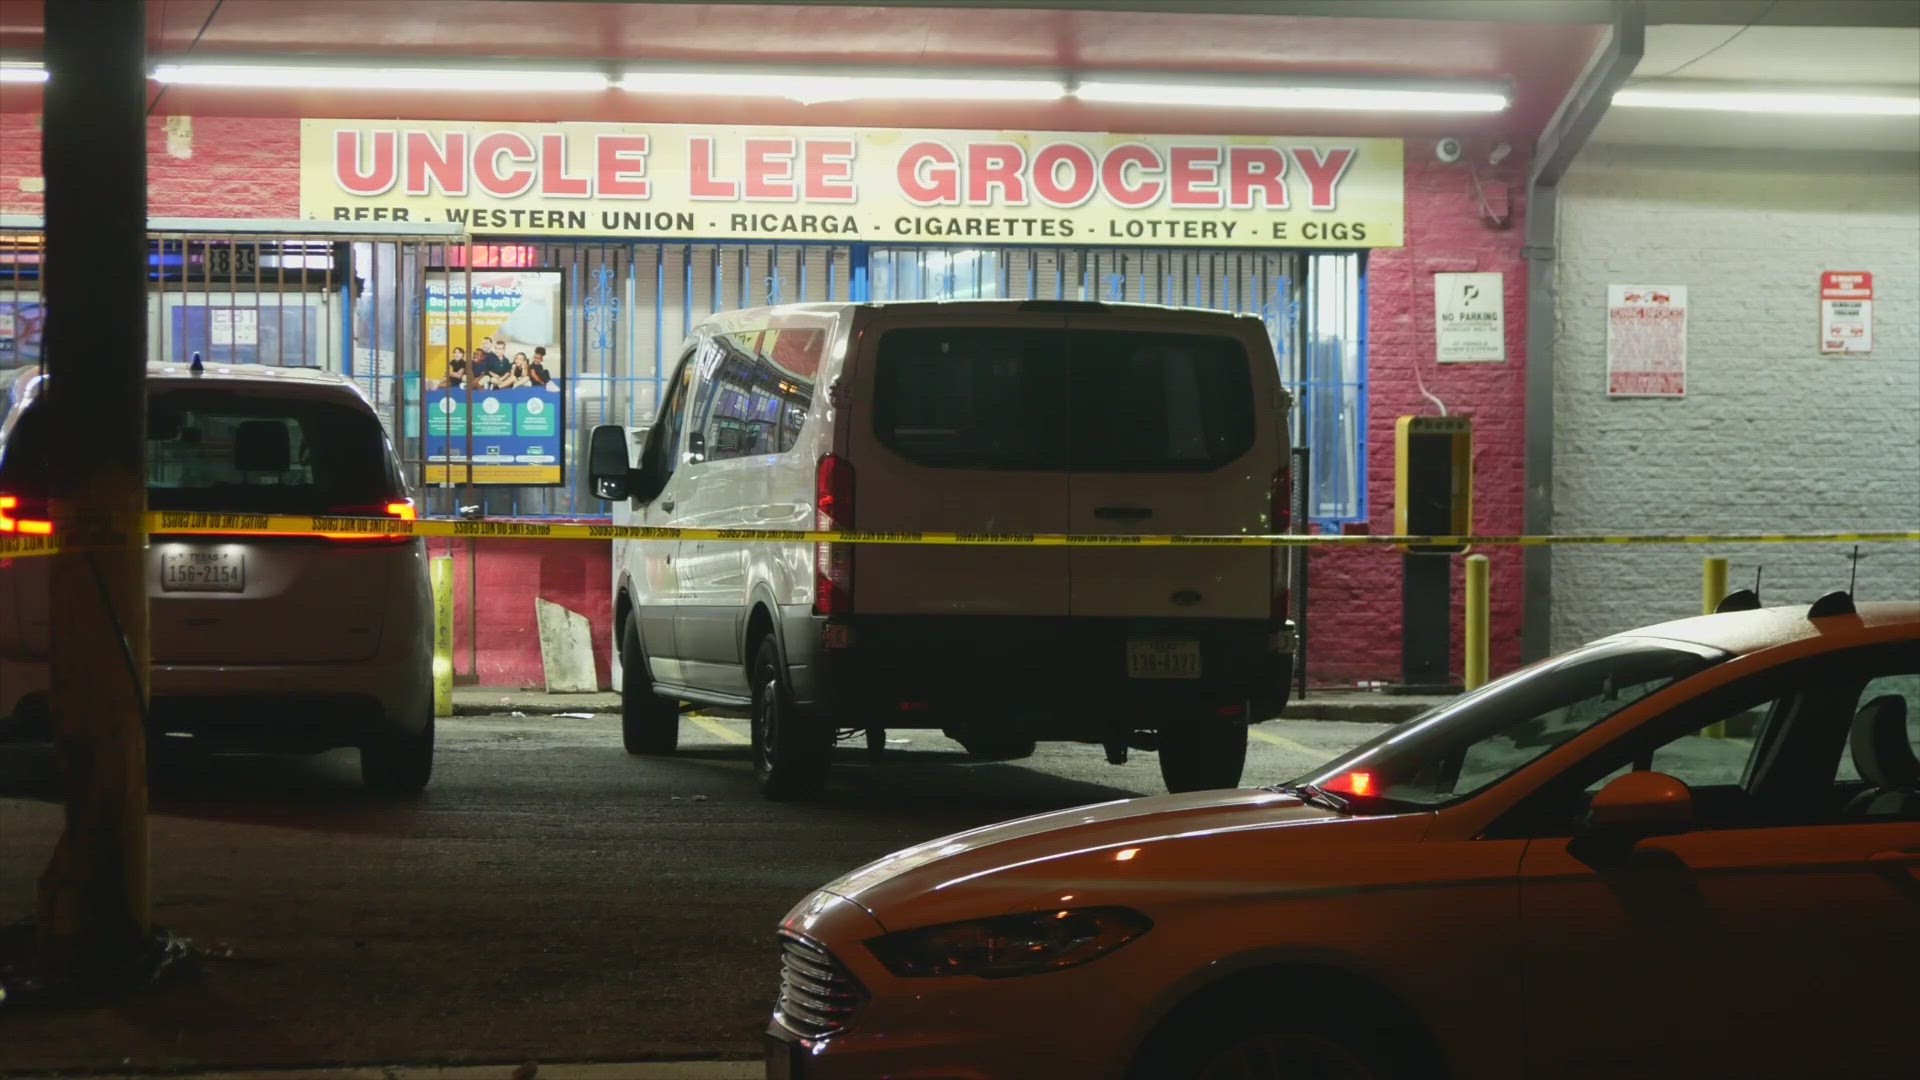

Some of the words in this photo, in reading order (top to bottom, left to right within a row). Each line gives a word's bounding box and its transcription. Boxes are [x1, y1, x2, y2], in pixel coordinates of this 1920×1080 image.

[333, 130, 651, 199] UNCLE
[687, 137, 858, 202] LEE
[895, 140, 1356, 211] GROCERY
[334, 206, 410, 222] BEER
[446, 207, 587, 230] WESTERN
[601, 211, 695, 232] UNION
[729, 212, 860, 235] RICARGA
[893, 215, 1076, 238] CIGARETTES
[1109, 218, 1238, 241] LOTTERY
[1271, 221, 1287, 241] E
[1300, 221, 1367, 242] CIGS
[1442, 313, 1454, 322] NO
[1460, 312, 1498, 322] PARKING
[161, 512, 189, 528] CROSS
[190, 512, 208, 528] NOT
[208, 513, 221, 529] DO
[221, 514, 240, 529] LINE
[240, 514, 268, 530] POLICE
[311, 518, 339, 531] CROSS
[339, 518, 355, 531] NOT
[355, 519, 368, 532] DO
[368, 519, 386, 532] LINE
[386, 520, 413, 533] POLICE
[454, 521, 479, 534] CROSS
[480, 522, 495, 534] NOT
[495, 522, 507, 535] DO
[507, 523, 524, 535] LINE
[524, 524, 550, 535] POLICE
[190, 553, 219, 562] TEXAS
[168, 565, 239, 583] 156-2154
